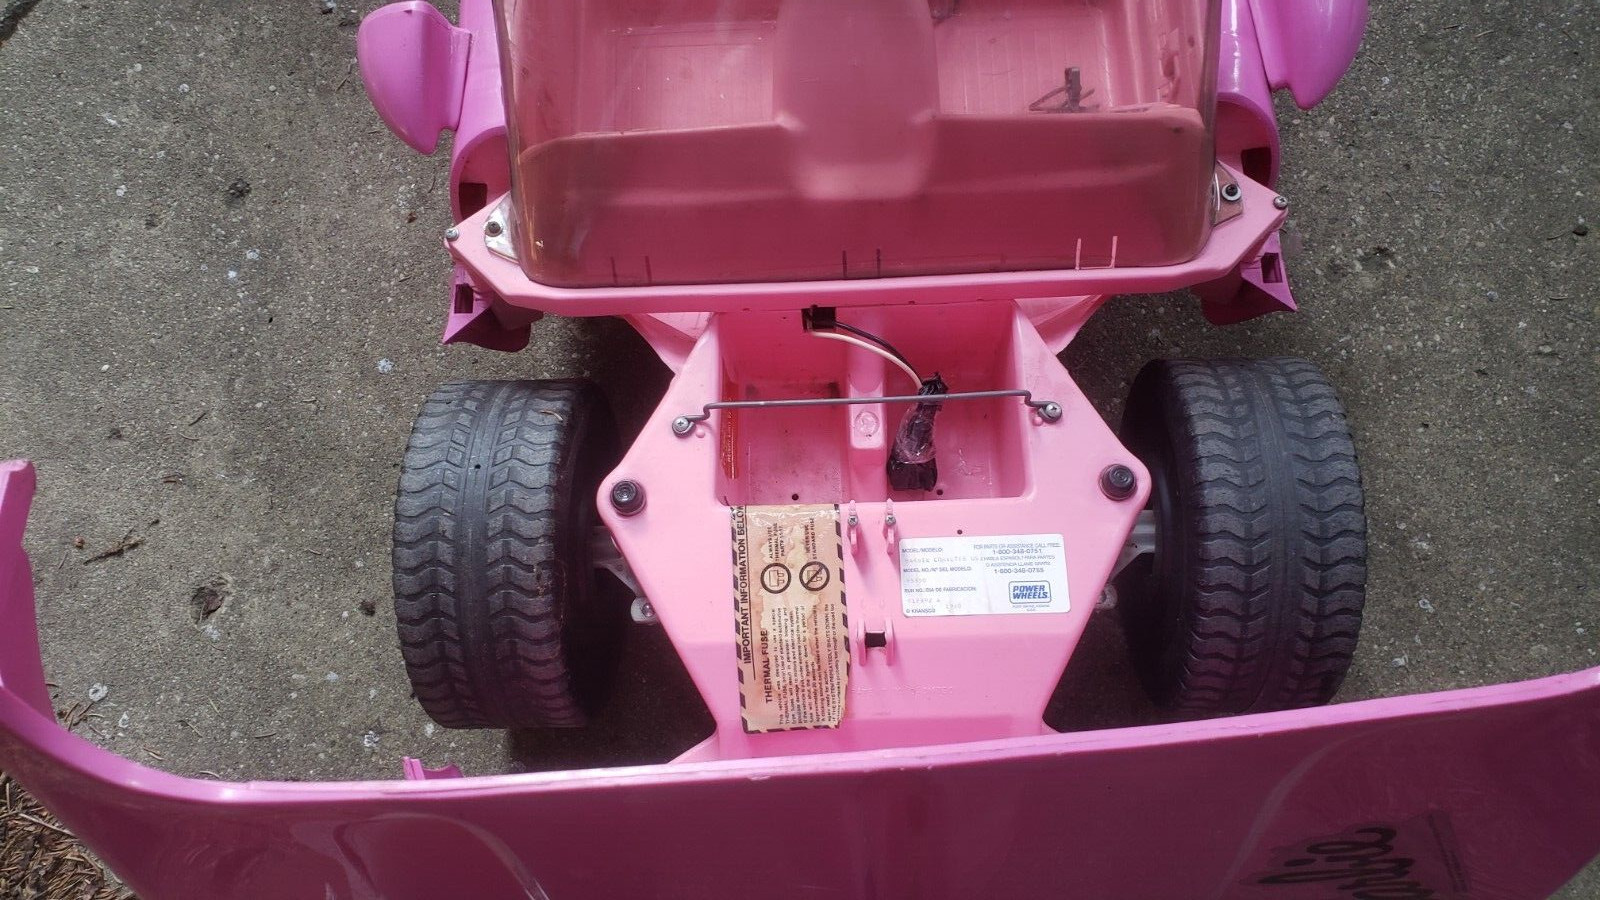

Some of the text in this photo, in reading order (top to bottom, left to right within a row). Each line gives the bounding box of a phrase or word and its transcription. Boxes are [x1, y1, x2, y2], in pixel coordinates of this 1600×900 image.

[738, 539, 748, 603] INFORMATION
[740, 607, 751, 664] IMPORTANT
[760, 630, 772, 703] THERMAL FUSE
